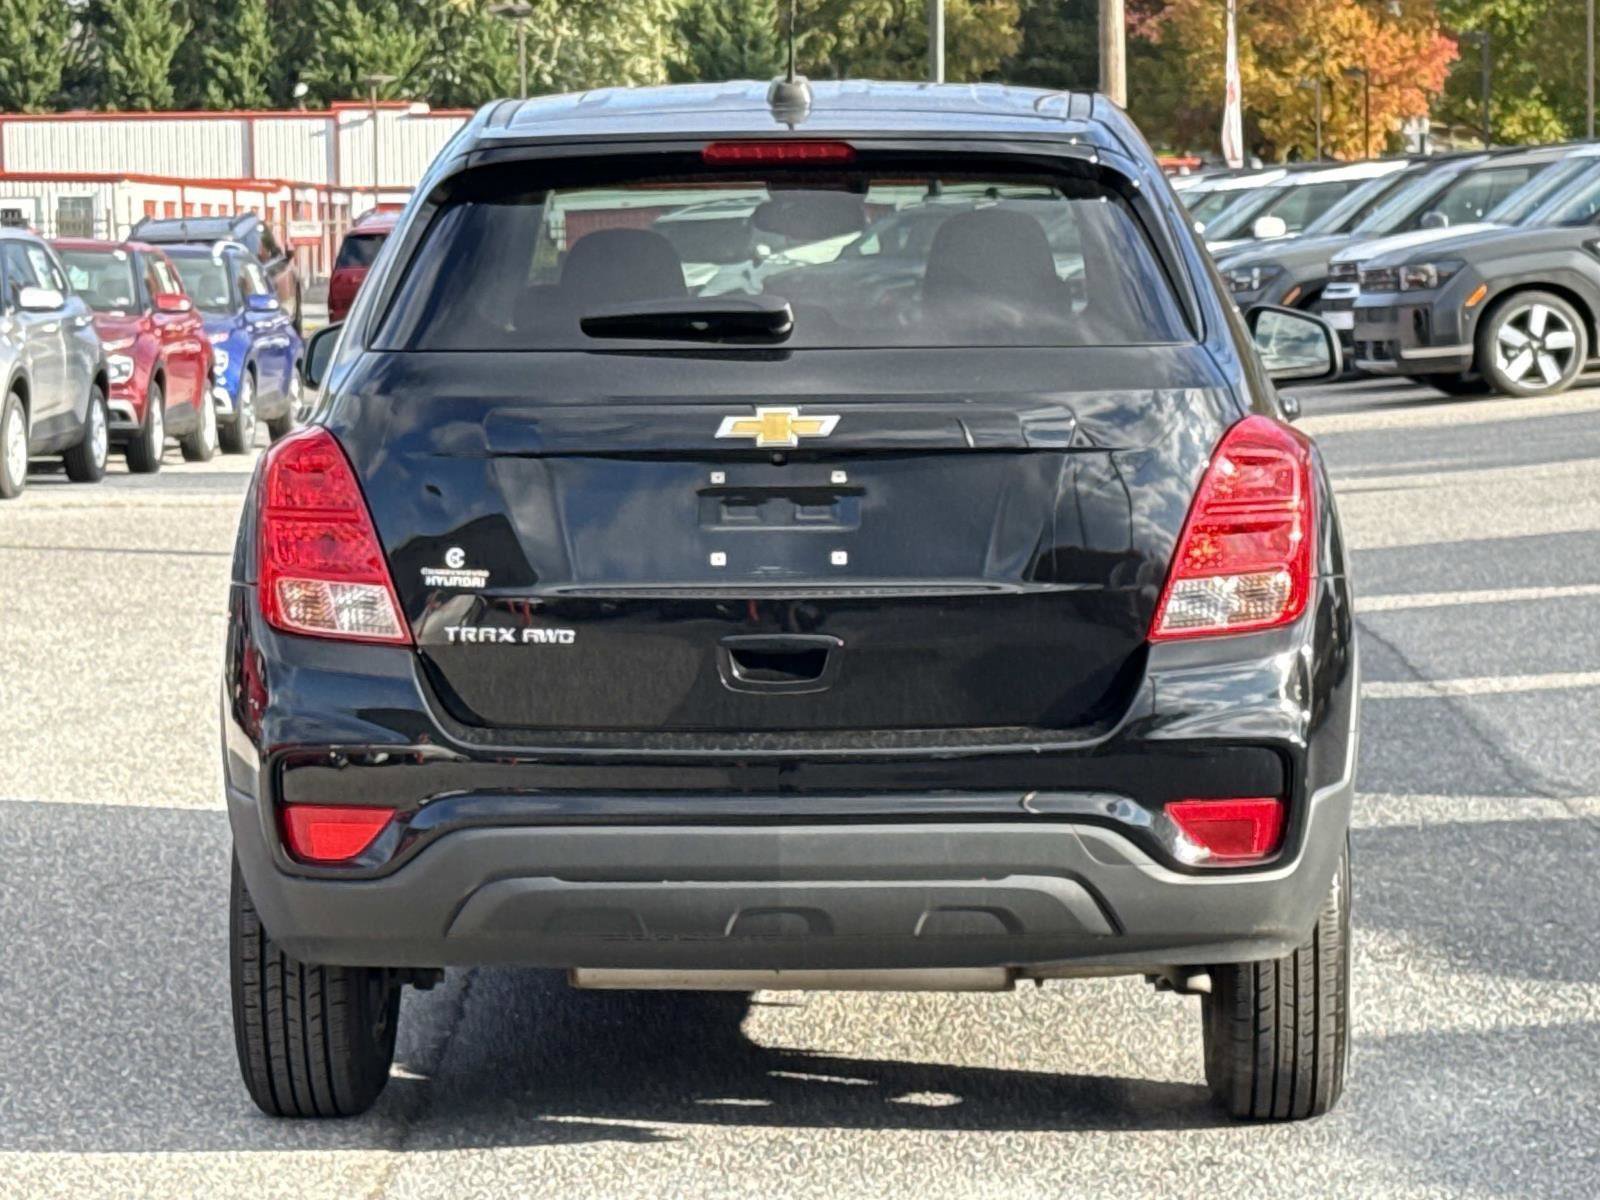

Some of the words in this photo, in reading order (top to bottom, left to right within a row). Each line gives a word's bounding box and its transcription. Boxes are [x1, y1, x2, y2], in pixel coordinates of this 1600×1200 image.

[424, 575, 486, 589] HYUNDAI
[444, 626, 517, 643] TRAX
[521, 628, 577, 645] AWD
